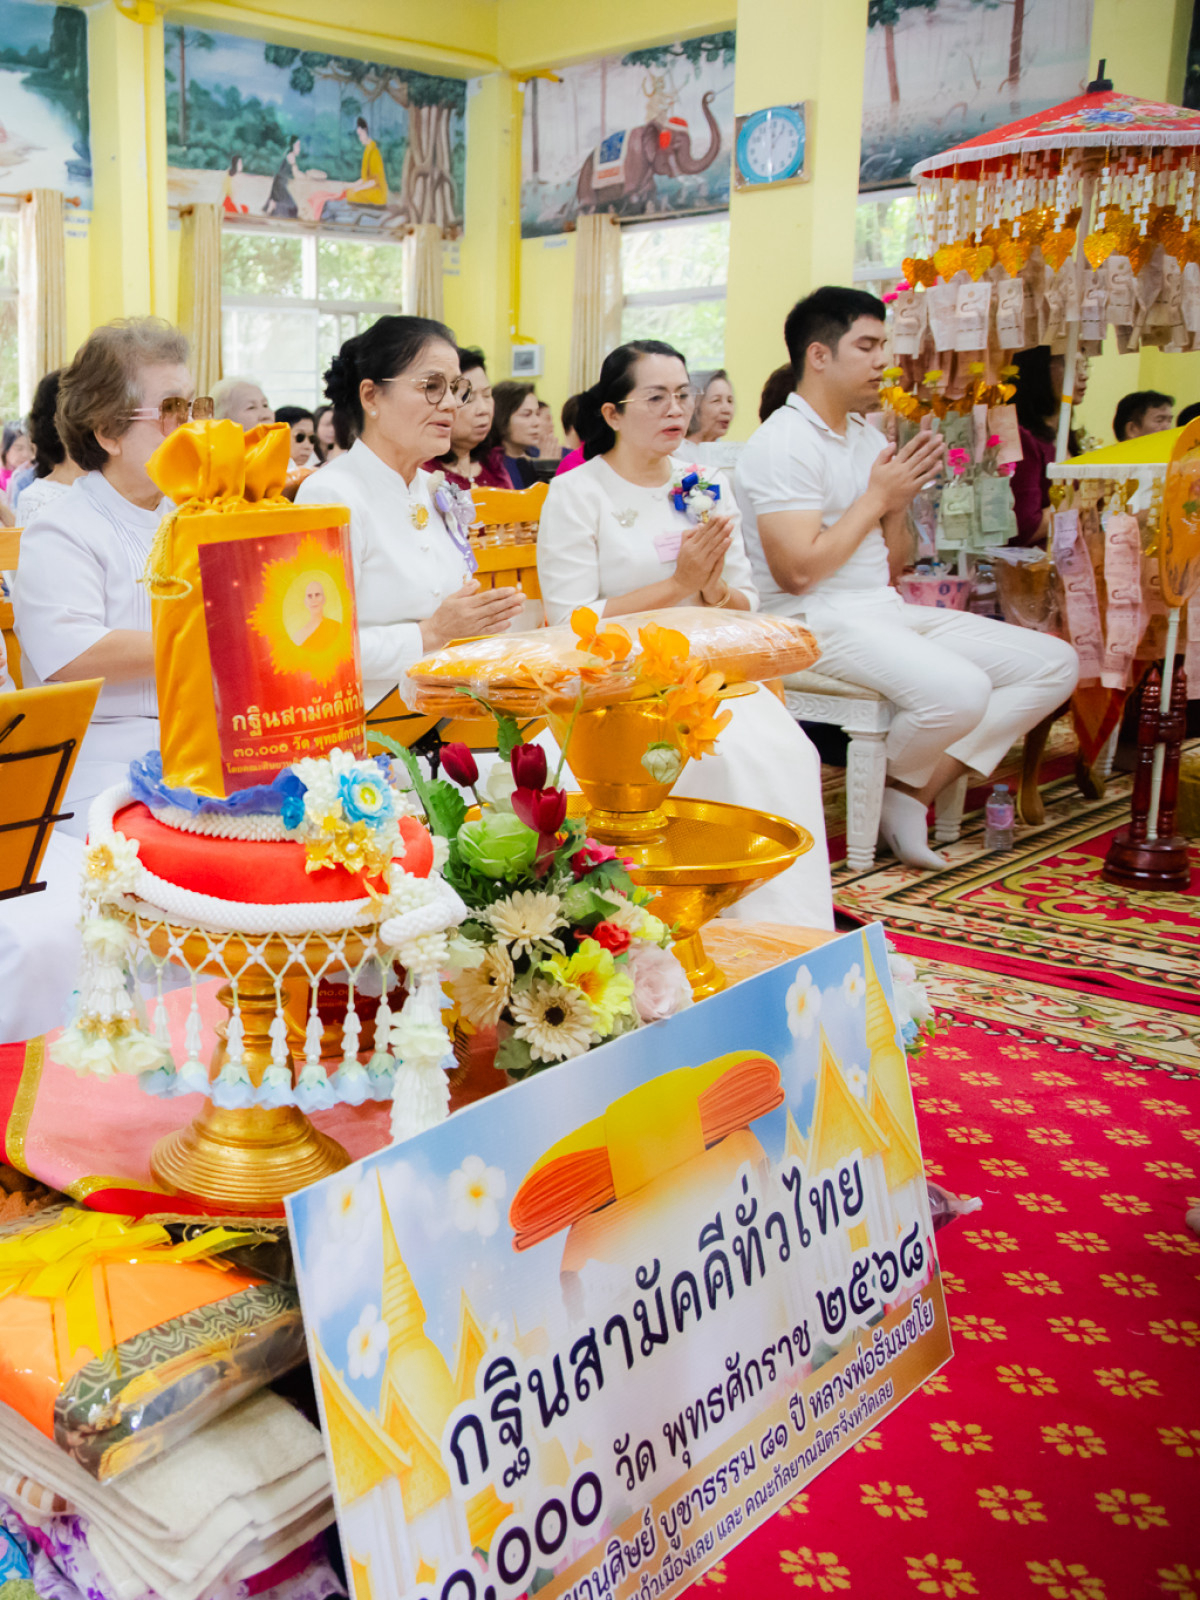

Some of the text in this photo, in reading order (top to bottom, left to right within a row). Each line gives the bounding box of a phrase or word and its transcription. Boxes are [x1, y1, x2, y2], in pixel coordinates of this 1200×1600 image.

[232, 682, 363, 736] กฐินสามัคคีทั่วไ
[293, 736, 310, 750] วัด
[450, 1160, 863, 1487] กฐินสามัคคีทั่วไทย
[614, 1433, 656, 1490] วัด
[663, 1320, 811, 1469] พุทธศักราช
[816, 1222, 924, 1334] ๒๕๖๘
[660, 1447, 755, 1549] บูชาธรรม
[760, 1424, 789, 1459] ๘๑
[790, 1393, 806, 1431] ปี
[810, 1297, 934, 1418] หลวงพ่อธัมมชโย
[631, 1380, 894, 1600] ก้วเมืองเลย และ คณะกัลยาณมิตรจังหวัดเลย
